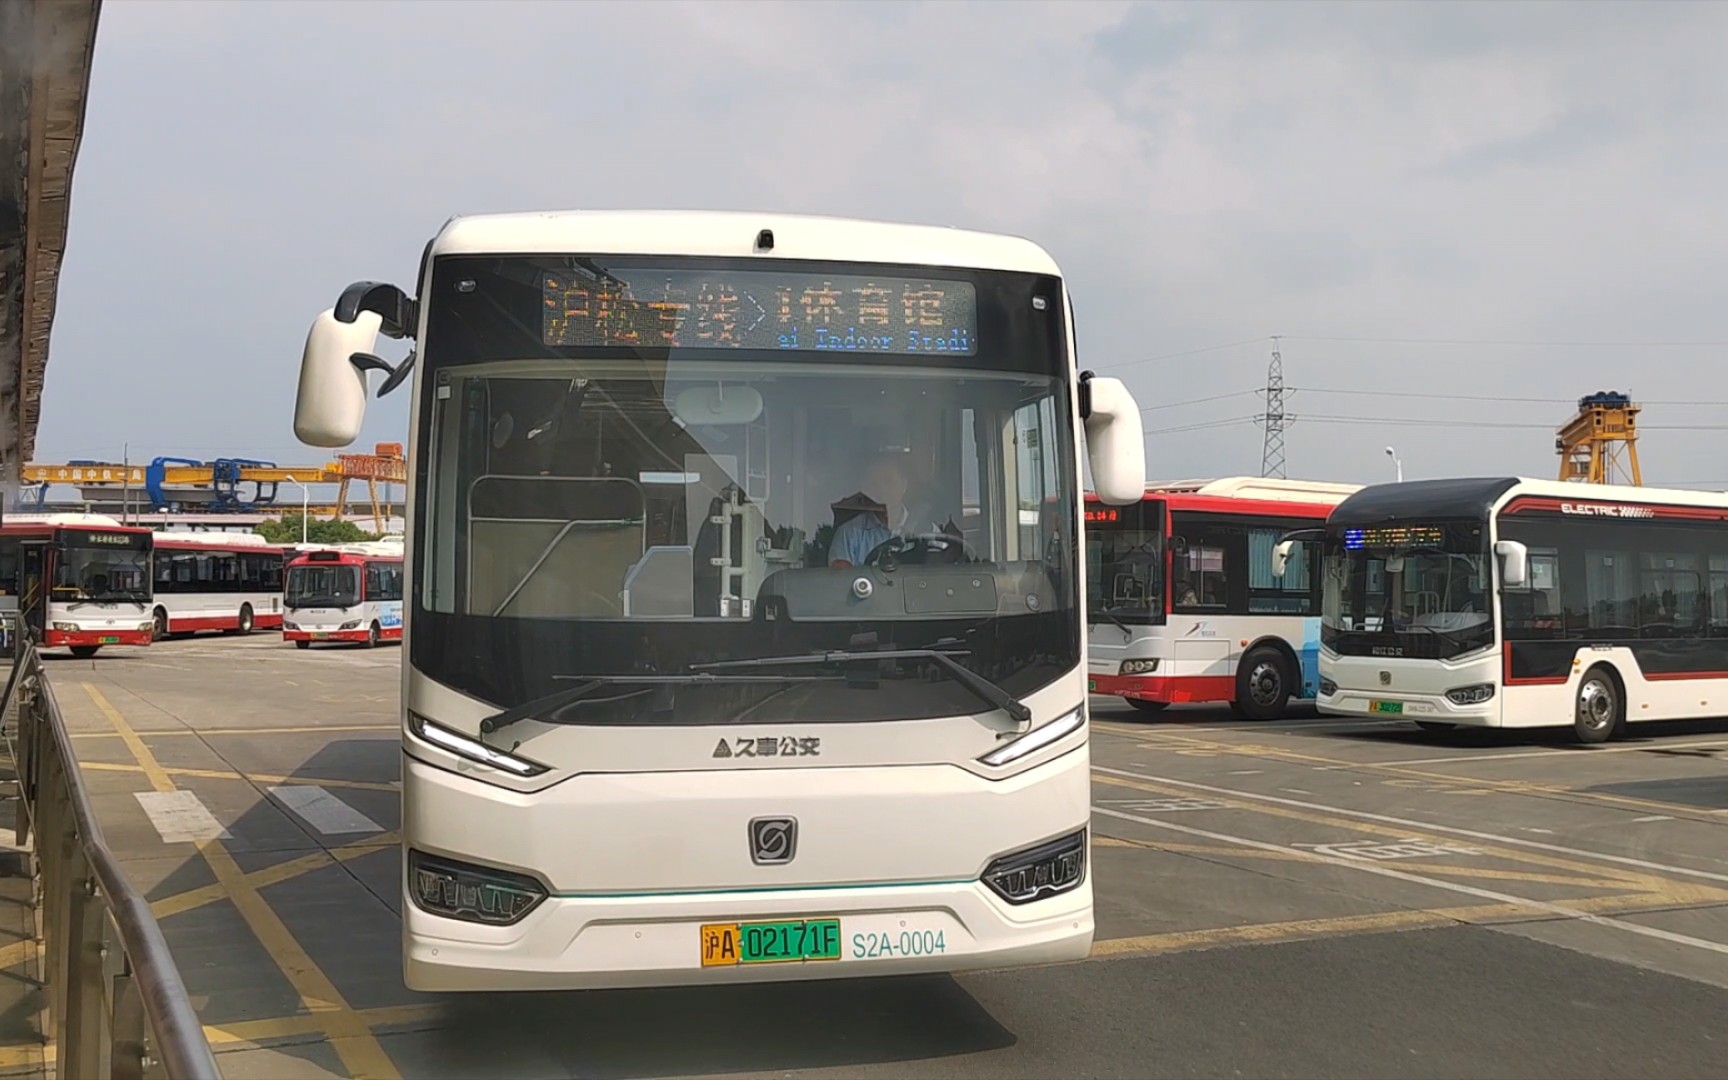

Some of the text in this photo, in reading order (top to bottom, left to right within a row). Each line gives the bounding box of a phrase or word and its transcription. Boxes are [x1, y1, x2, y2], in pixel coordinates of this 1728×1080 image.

[1560, 503, 1618, 517] ELECTRIC
[734, 736, 820, 758] 久事公交
[853, 930, 946, 958] S2A-0004
